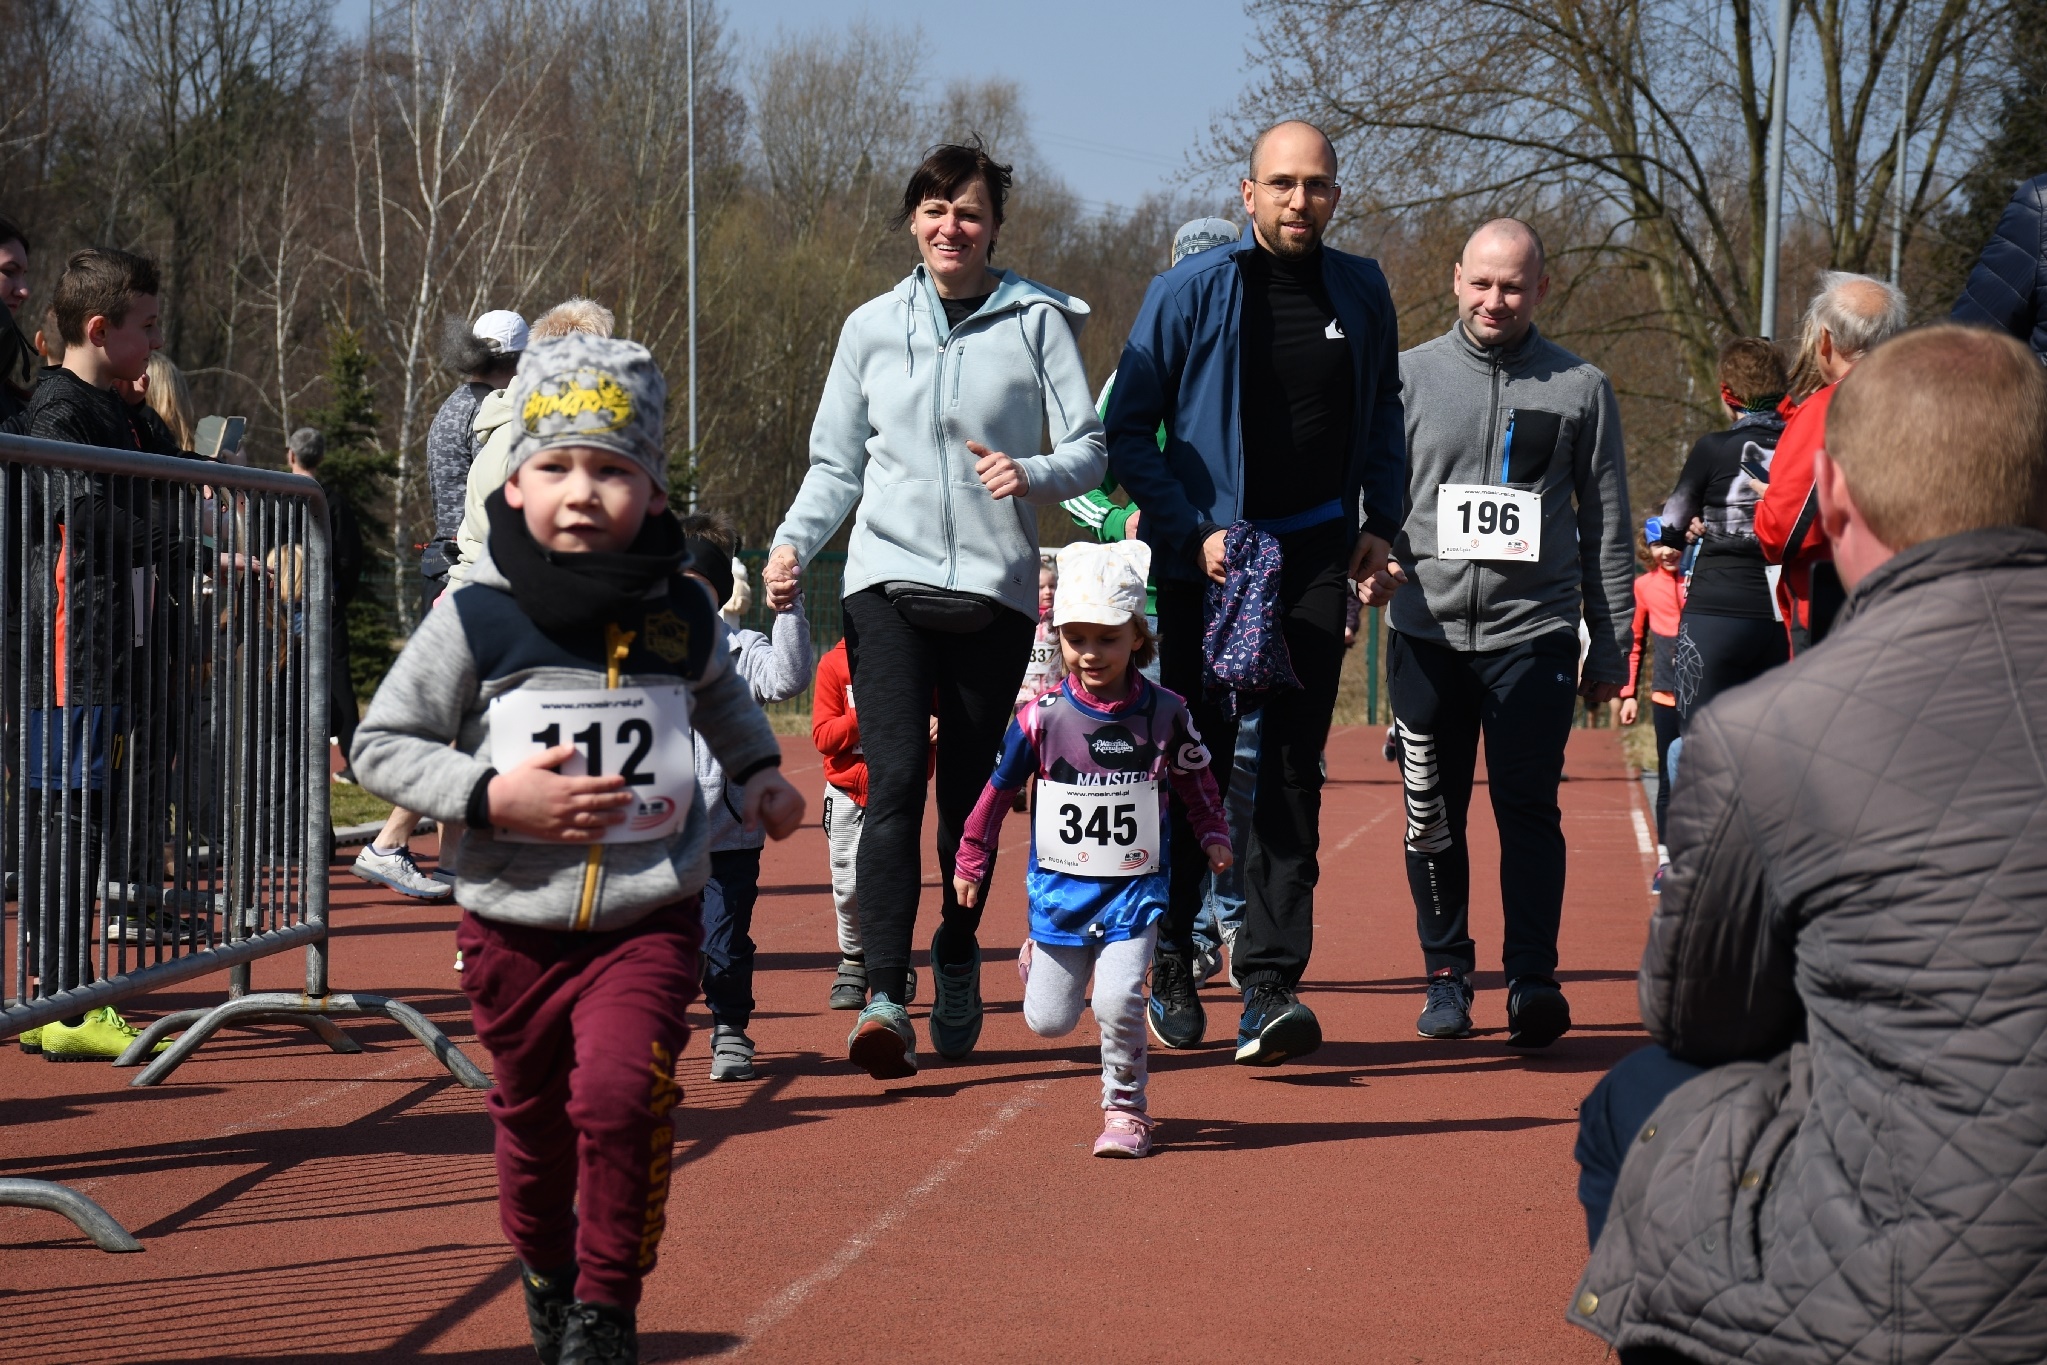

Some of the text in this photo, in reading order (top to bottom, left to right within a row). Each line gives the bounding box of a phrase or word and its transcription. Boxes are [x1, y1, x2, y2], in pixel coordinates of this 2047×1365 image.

[1457, 501, 1520, 536] 196
[531, 718, 655, 786] 112
[1059, 803, 1138, 846] 345
